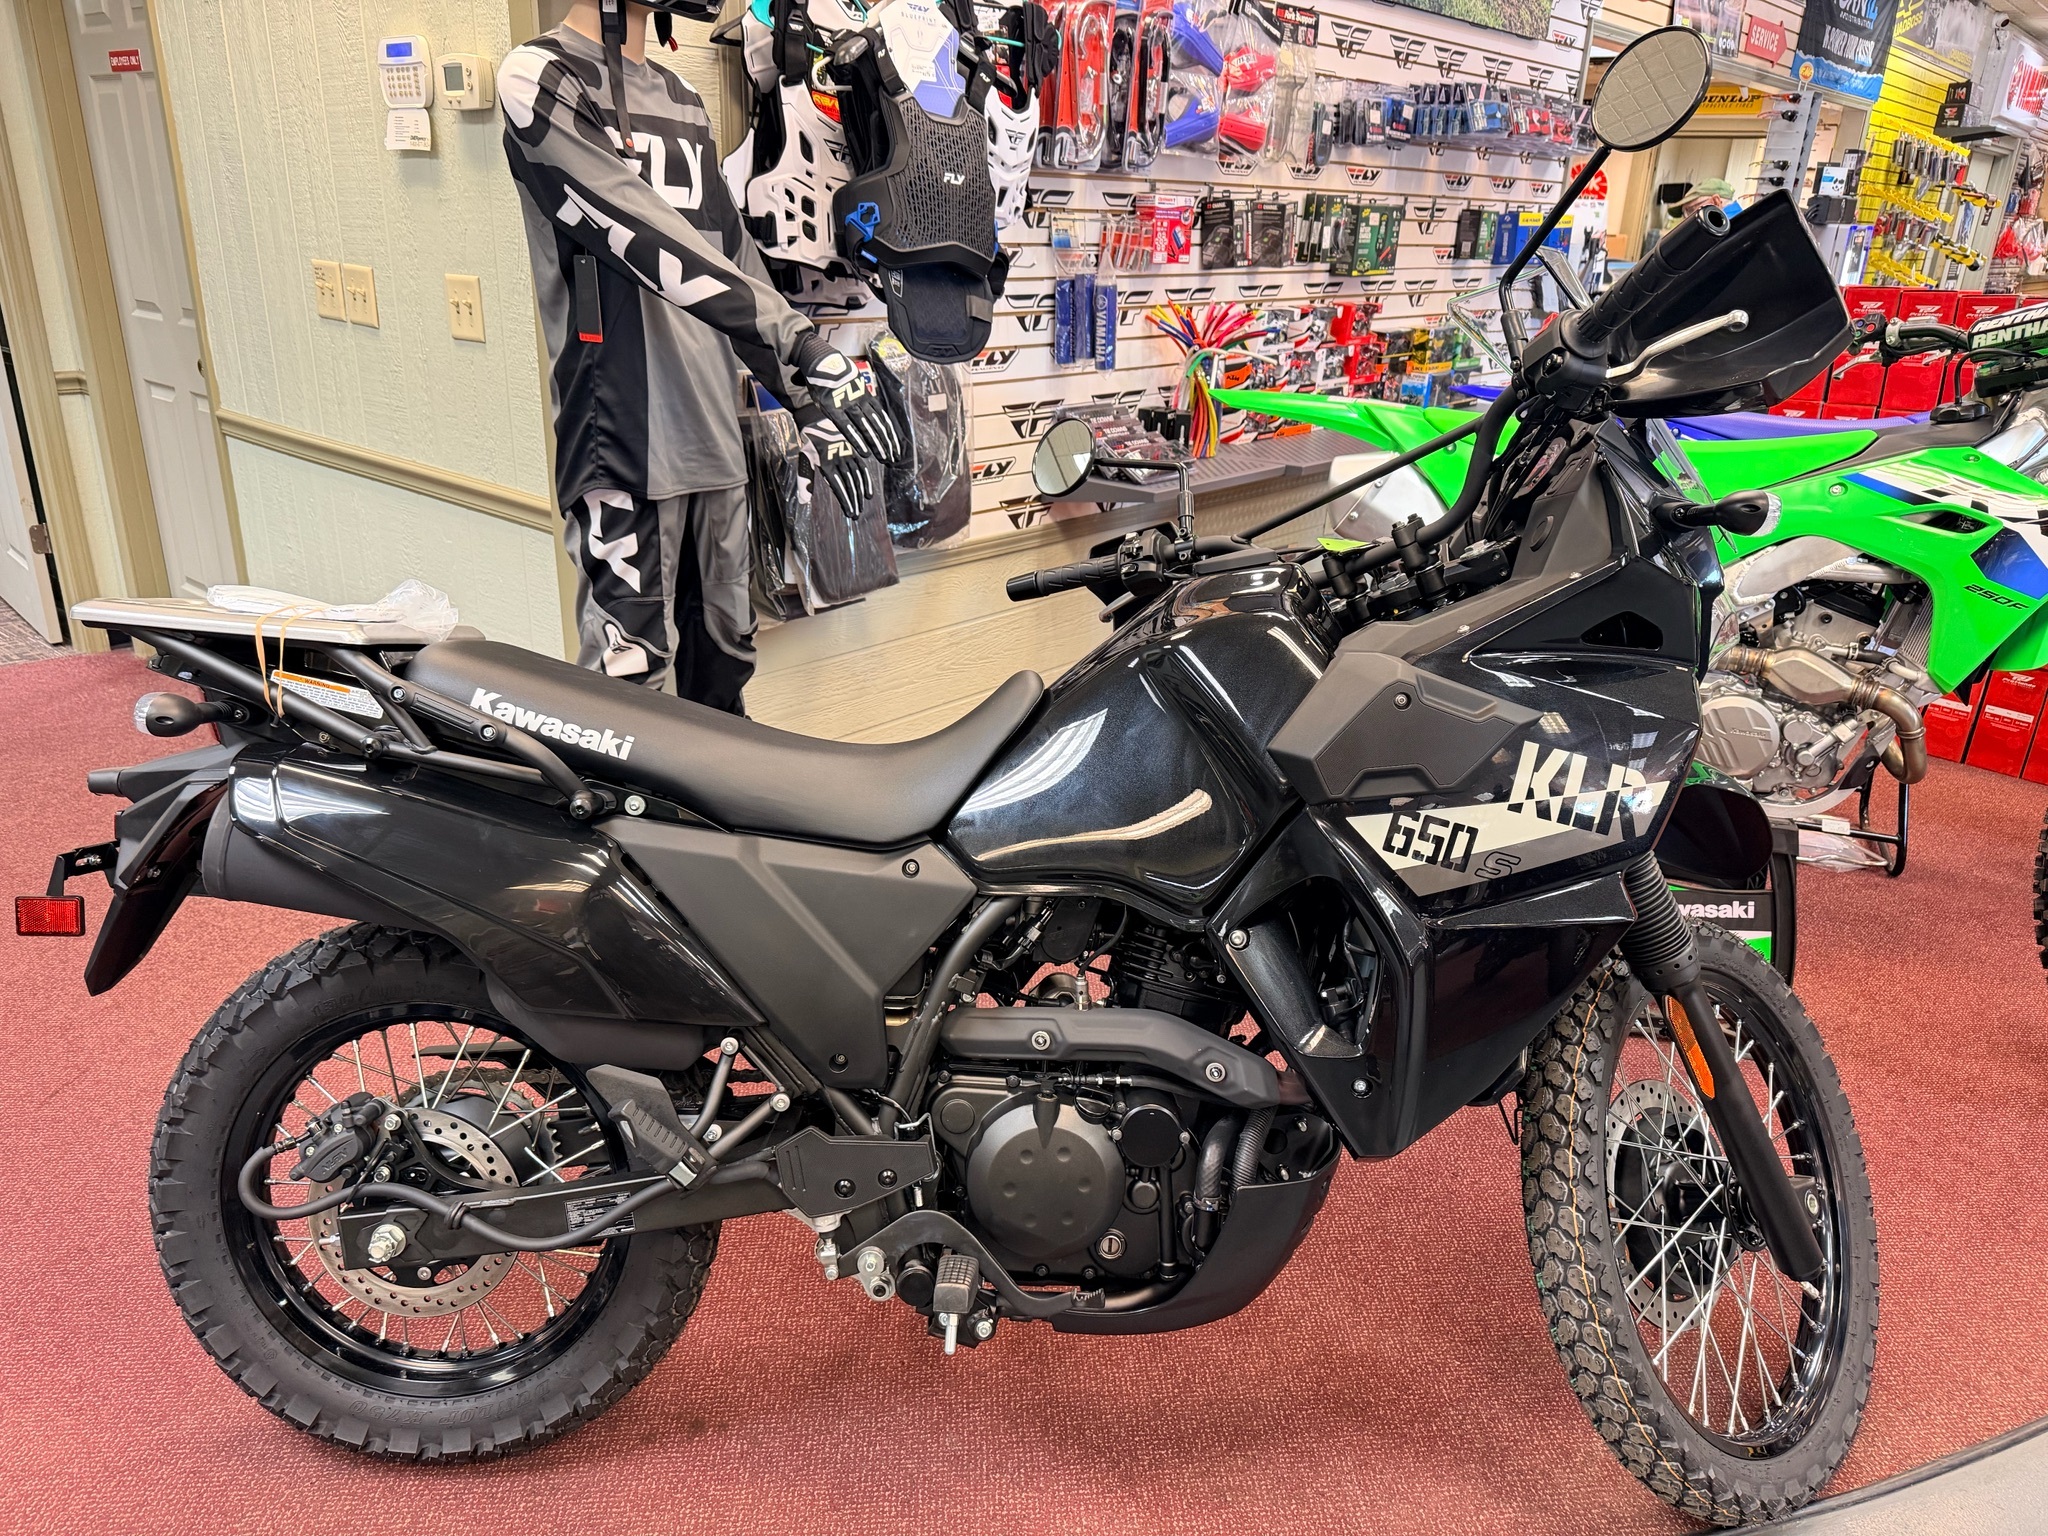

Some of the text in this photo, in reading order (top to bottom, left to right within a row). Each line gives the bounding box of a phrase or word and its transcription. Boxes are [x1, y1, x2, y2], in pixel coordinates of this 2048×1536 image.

[1751, 25, 1779, 53] SERVICE
[943, 172, 966, 186] FLY
[1347, 168, 1381, 181] FLY
[1444, 174, 1473, 187] FLY
[1491, 177, 1517, 189] FLY
[1530, 182, 1553, 194] FLY
[555, 183, 732, 307] FLY
[1095, 309, 1107, 362] YAMAHA
[832, 376, 866, 409] FLY
[1963, 583, 2030, 610] 250F
[304, 678, 331, 689] WARNING
[470, 688, 635, 761] Kawasaki
[1507, 741, 1652, 841] KLR
[1382, 810, 1522, 880] 650 S
[1677, 901, 1755, 918] wasaki
[349, 1400, 428, 1425] K750
